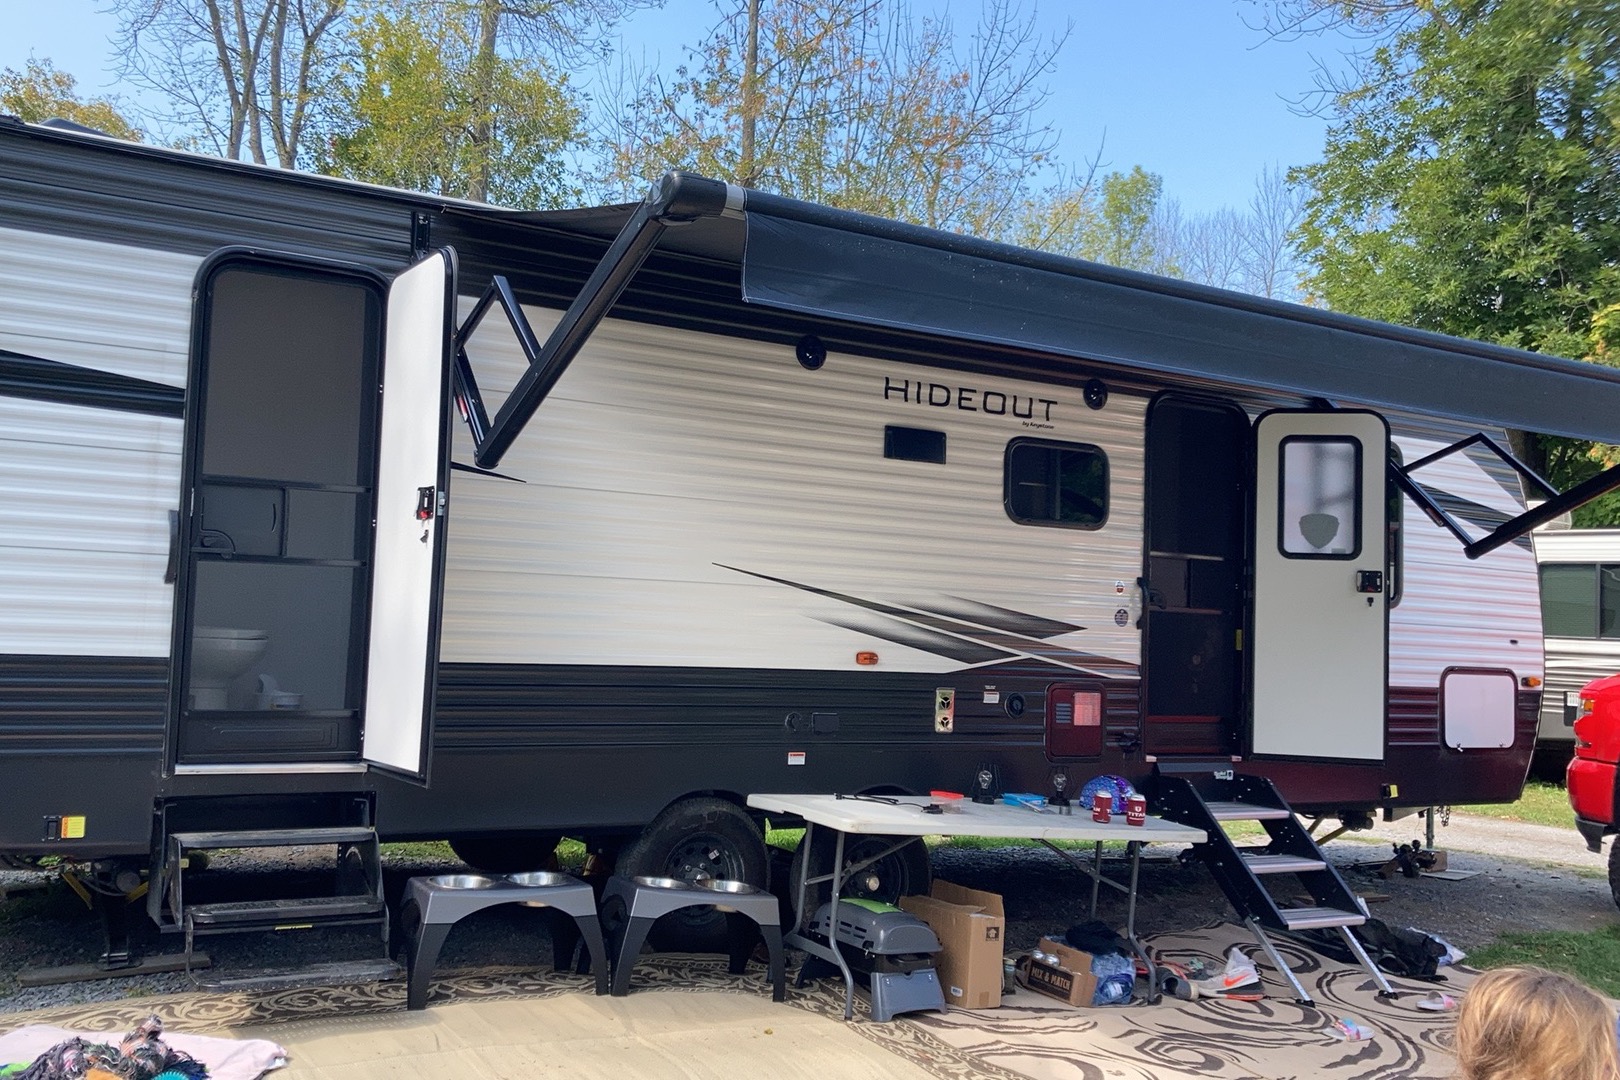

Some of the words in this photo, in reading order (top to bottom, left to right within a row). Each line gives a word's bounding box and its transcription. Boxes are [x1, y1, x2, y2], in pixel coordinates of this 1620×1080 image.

[884, 376, 1058, 421] HIDEOUT
[1031, 966, 1044, 979] MIX
[1050, 974, 1071, 990] MATCH
